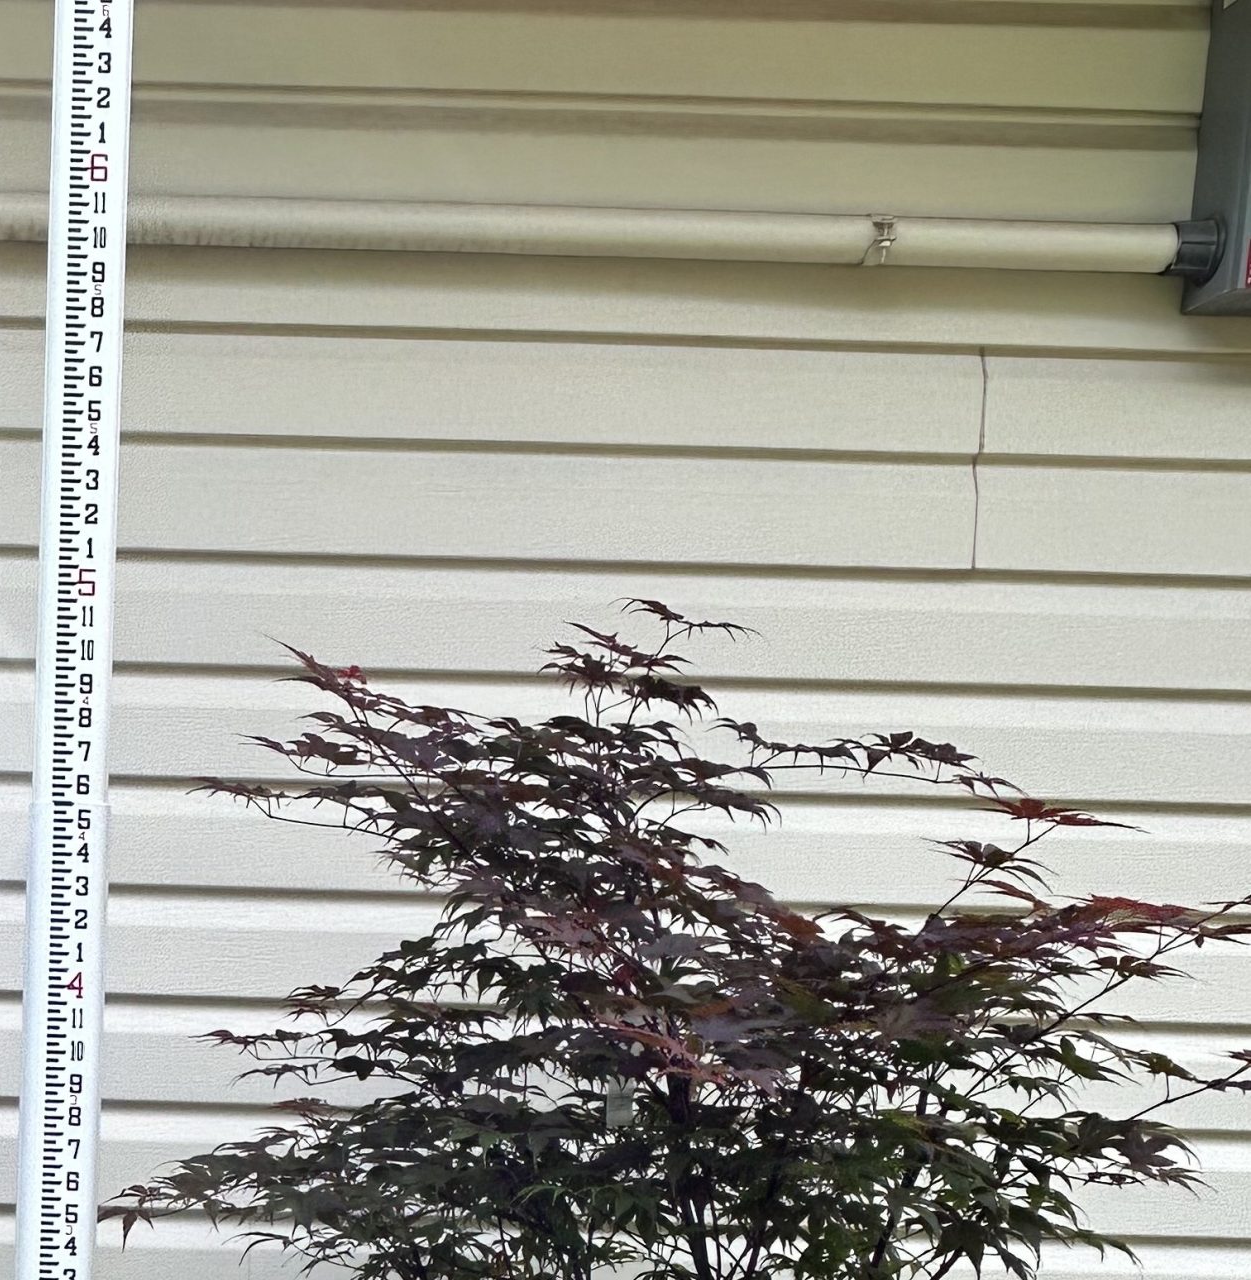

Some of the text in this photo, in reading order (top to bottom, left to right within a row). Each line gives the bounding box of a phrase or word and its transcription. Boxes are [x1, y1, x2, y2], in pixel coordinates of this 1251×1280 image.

[99, 17, 112, 38] 4
[98, 52, 112, 74] 3
[96, 87, 111, 109] 2
[98, 121, 106, 144] 1
[90, 153, 108, 182] 6
[93, 191, 106, 214] 11
[93, 226, 106, 249] 10
[91, 261, 106, 283] 9
[91, 296, 104, 318] 8
[90, 331, 104, 353] 7
[89, 365, 103, 387] 6
[87, 400, 102, 422] 5
[87, 435, 100, 456] 4
[85, 469, 99, 491] 3
[84, 503, 99, 524] 2
[86, 537, 94, 559] 1
[78, 568, 96, 596] 5
[81, 605, 94, 627] 11
[80, 639, 94, 661] 10
[79, 673, 93, 695] 9
[78, 707, 92, 728] 8
[77, 741, 91, 762] 7
[76, 774, 90, 795] 6
[77, 809, 92, 830] 5
[76, 843, 90, 863] 4
[75, 876, 89, 896] 3
[74, 909, 88, 930] 2
[76, 942, 84, 963] 1
[66, 971, 83, 999] 4
[71, 1008, 83, 1029] 11
[70, 1040, 84, 1061] 10
[69, 1074, 83, 1094] 9
[68, 1106, 82, 1126] 8
[67, 1139, 81, 1160] 7
[66, 1171, 80, 1192] 6
[65, 1204, 79, 1224] 5
[64, 1236, 77, 1257] 4
